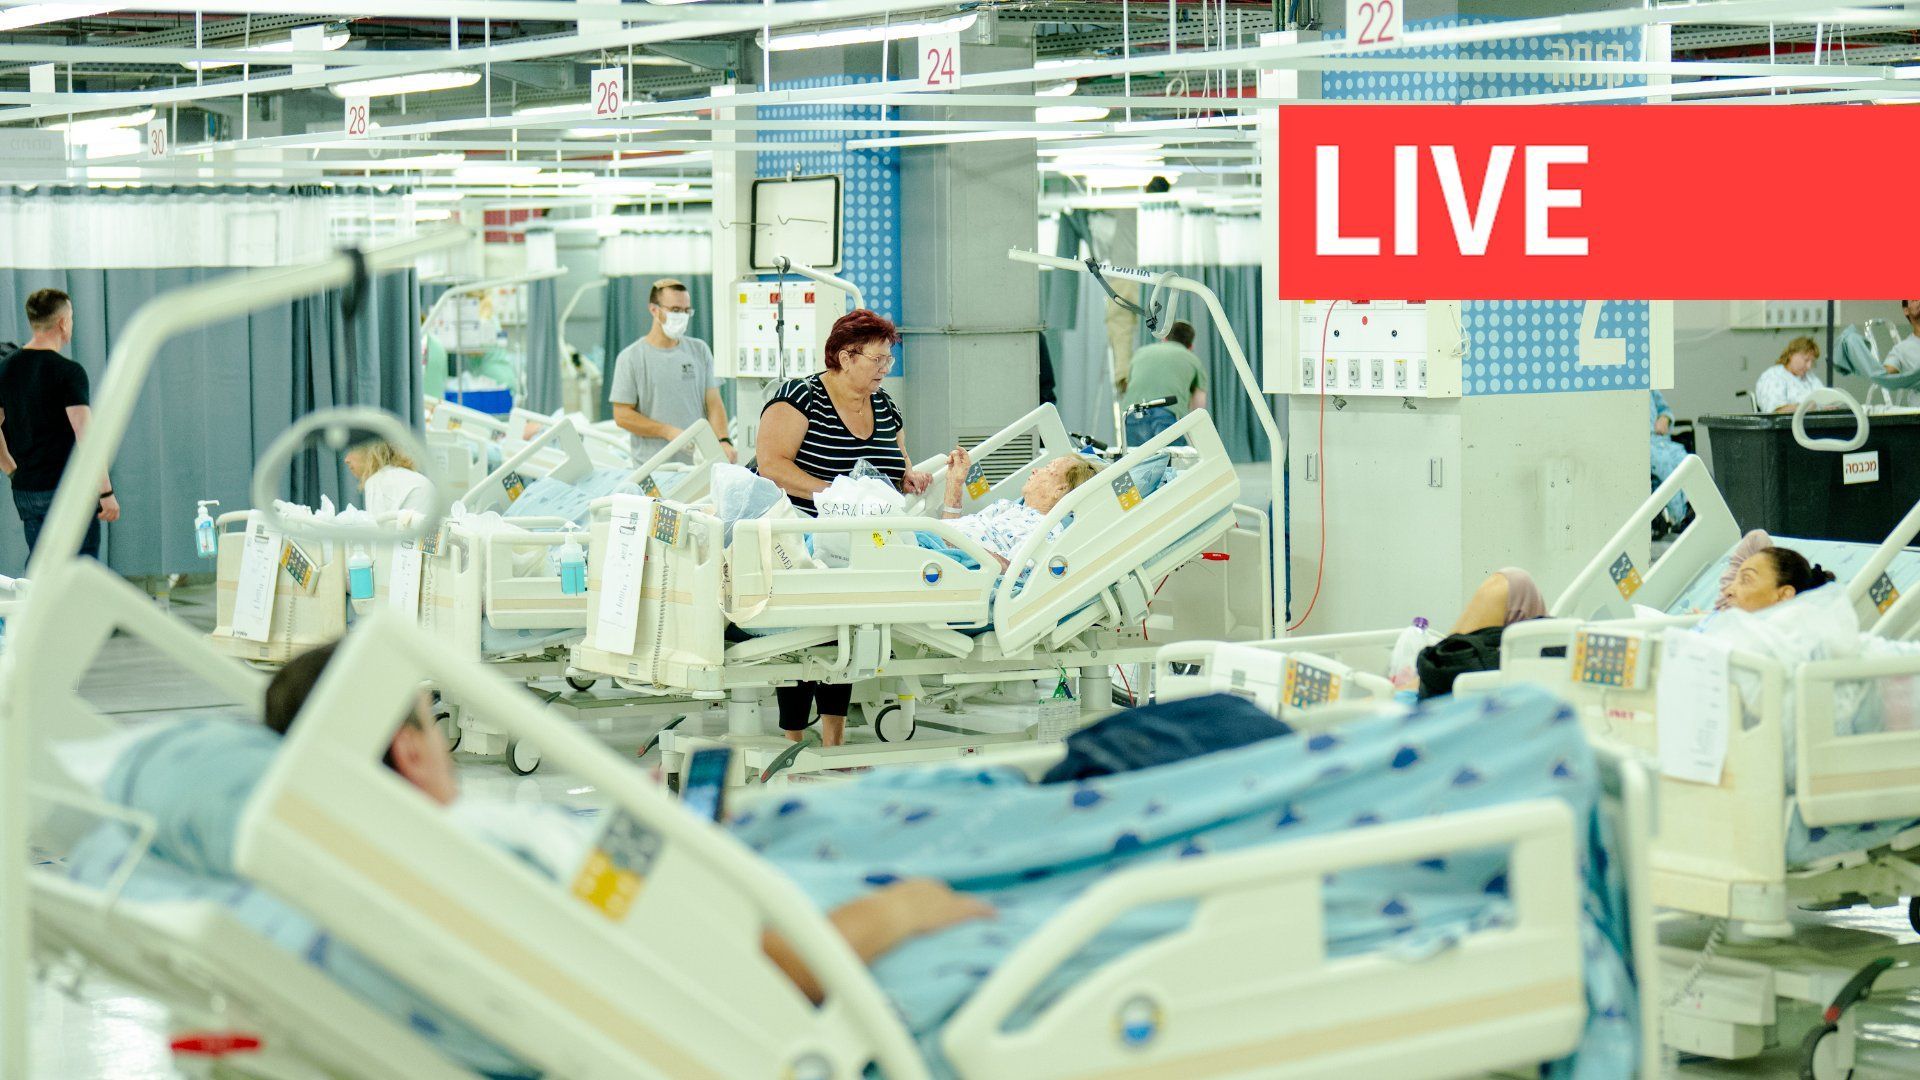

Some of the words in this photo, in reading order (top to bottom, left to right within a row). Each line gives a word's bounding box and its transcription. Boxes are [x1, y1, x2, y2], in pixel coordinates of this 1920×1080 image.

[1358, 0, 1394, 45] 22
[927, 47, 955, 85] 24
[597, 80, 618, 115] 26
[348, 105, 366, 135] 28
[151, 128, 165, 156] 30
[1845, 460, 1877, 475] מכבסה
